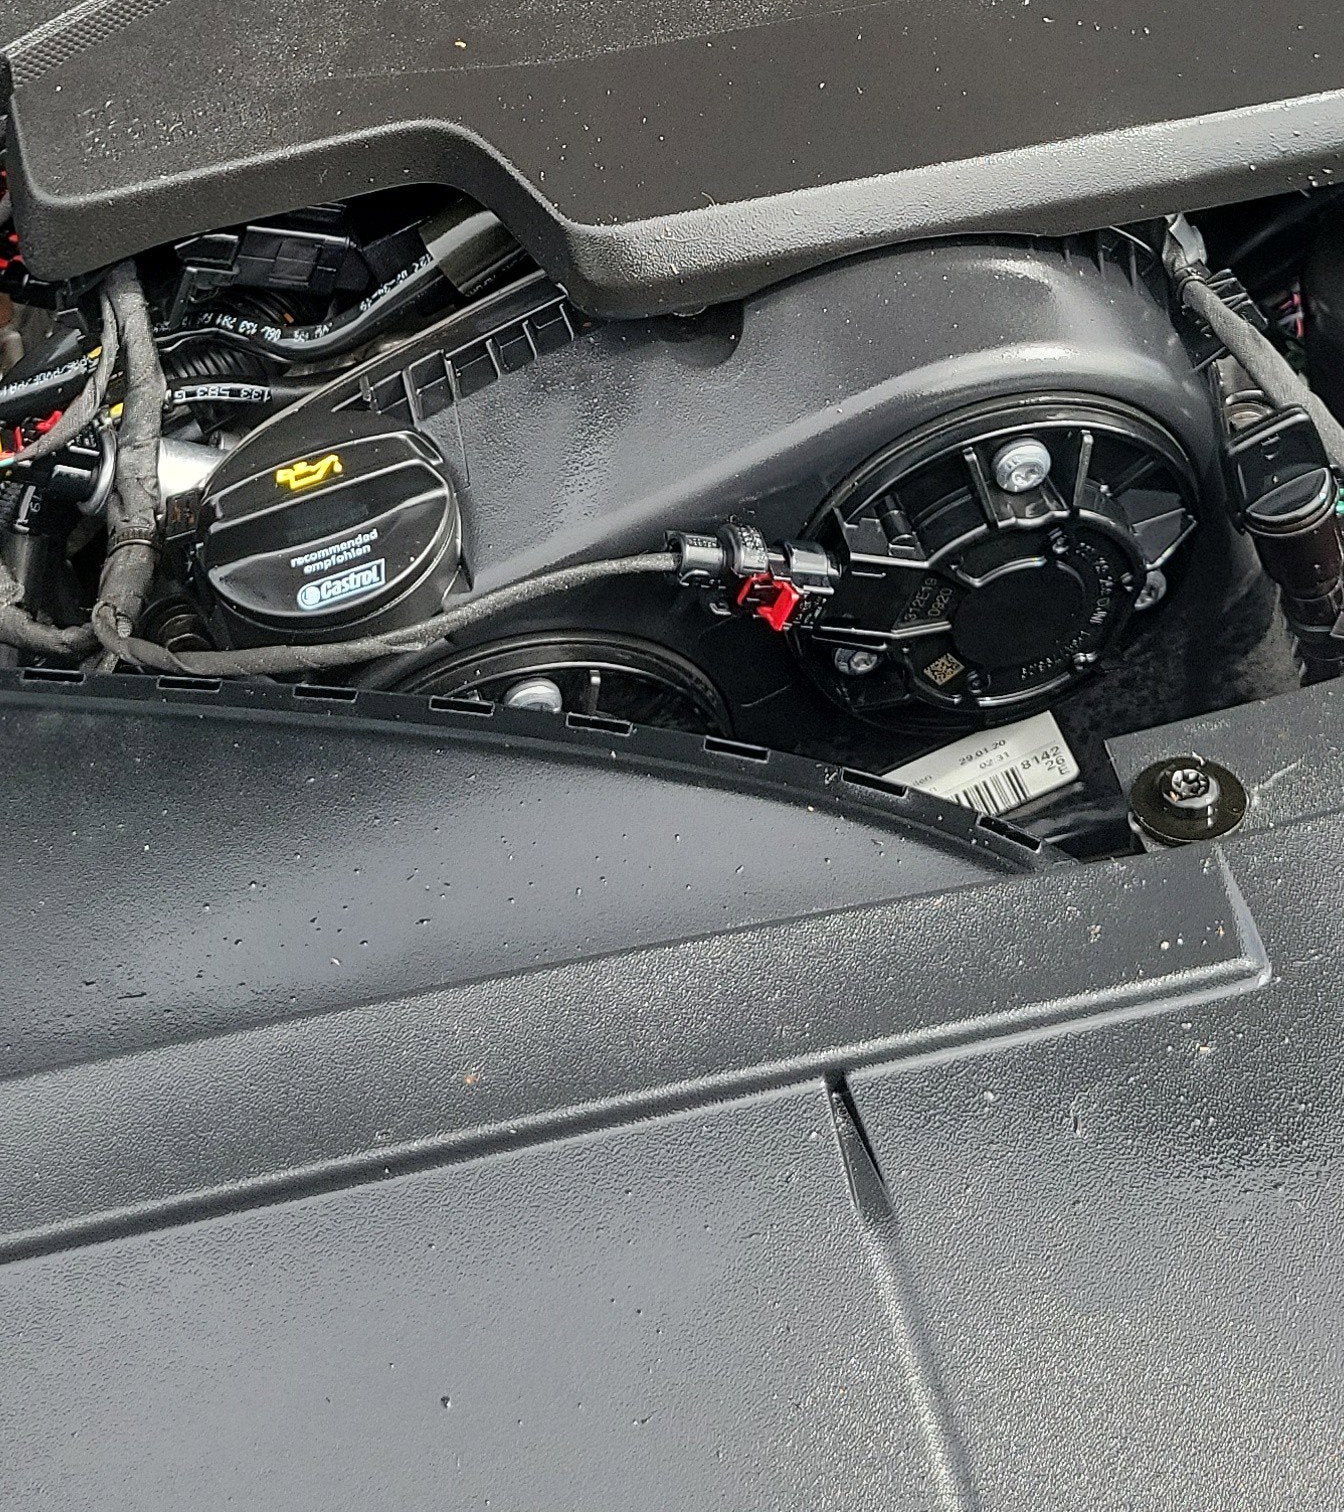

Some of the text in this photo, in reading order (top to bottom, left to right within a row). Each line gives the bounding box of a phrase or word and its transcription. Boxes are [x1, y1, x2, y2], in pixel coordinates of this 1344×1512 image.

[320, 564, 381, 600] Castrol
[1020, 745, 1061, 771] 8142
[1044, 755, 1067, 772] 26
